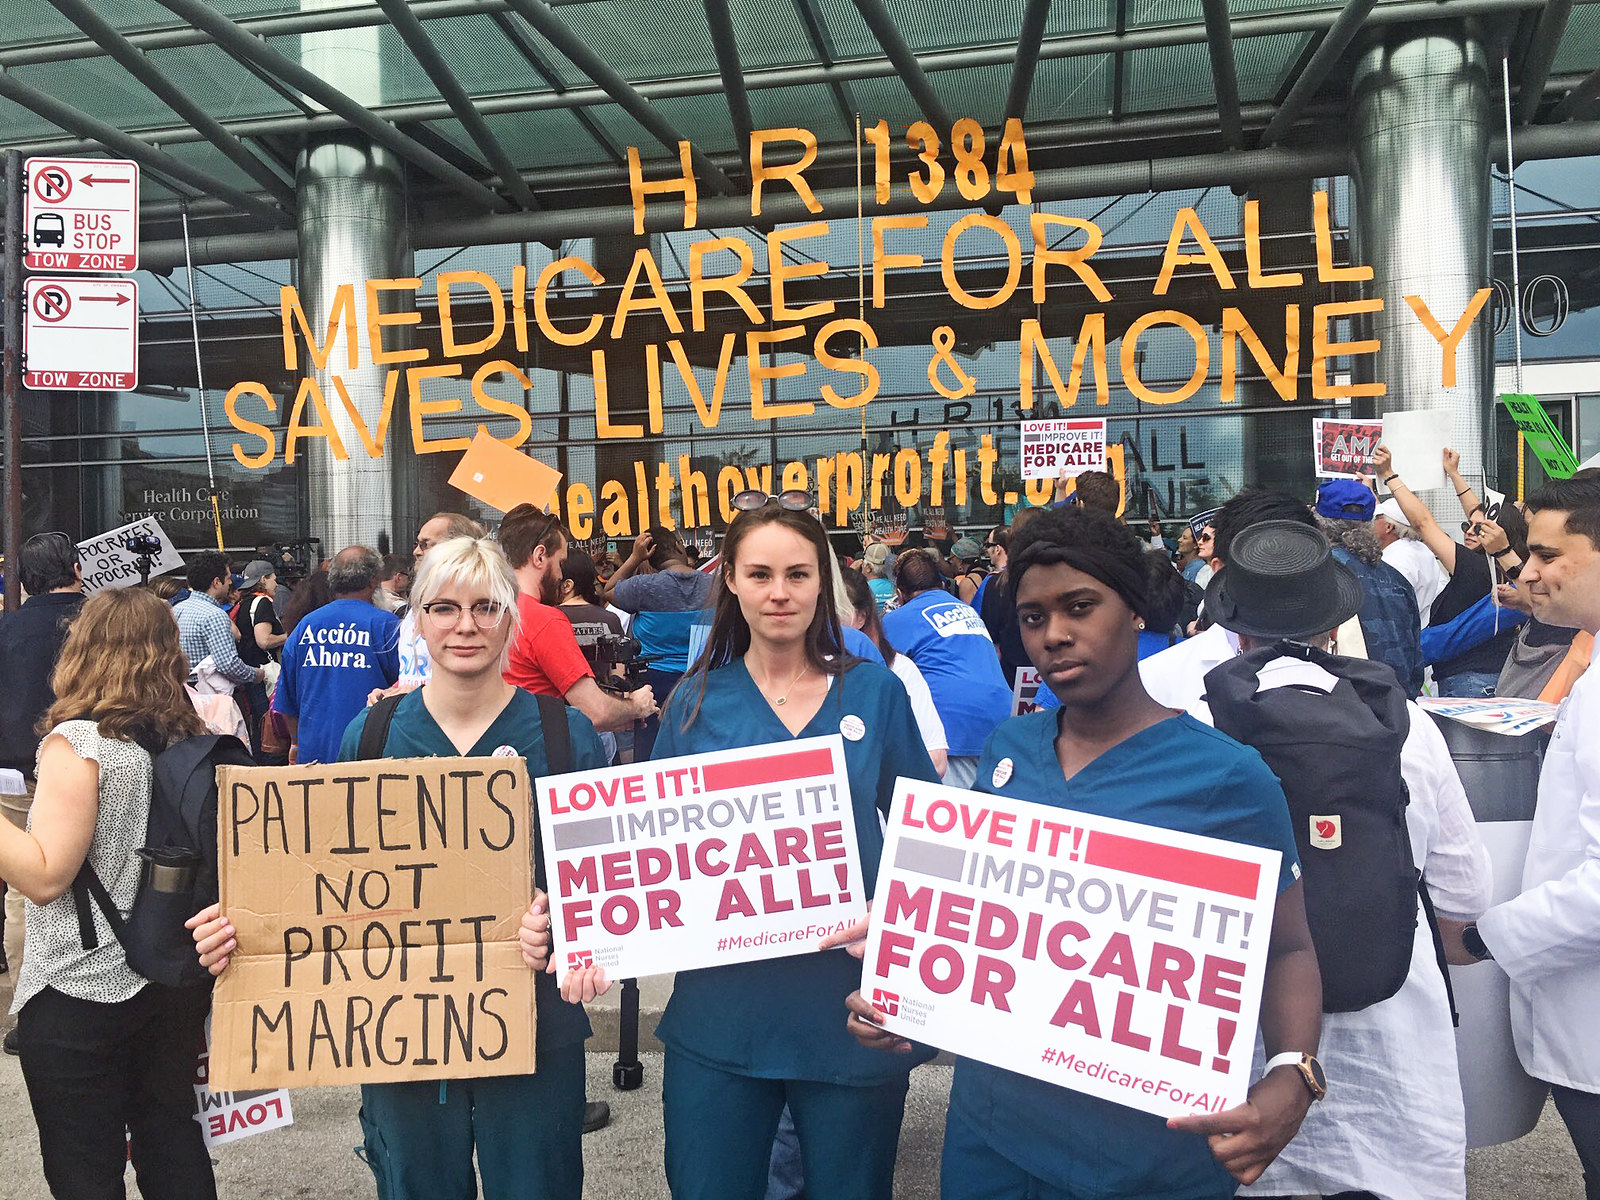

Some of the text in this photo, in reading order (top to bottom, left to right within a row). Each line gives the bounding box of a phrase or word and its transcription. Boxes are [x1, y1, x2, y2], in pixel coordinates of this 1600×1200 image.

[627, 116, 1036, 236] H R 1384
[73, 213, 112, 231] BUS
[73, 233, 122, 250] STOP
[32, 253, 127, 269] TOW ZONE
[280, 189, 1375, 371] MEDICARE FOR ALL
[31, 371, 126, 388] TOW ZONE
[224, 359, 535, 470] SAVES
[592, 317, 880, 441] LIVES
[926, 324, 978, 400] &
[1023, 422, 1067, 432] LOVE IT!
[1041, 431, 1103, 442] IMPROVE IT!
[1023, 441, 1103, 456] MEDICARE
[1023, 453, 1103, 469] FOR ALL!
[143, 487, 191, 503] Health
[170, 505, 259, 523] Corpoation
[96, 553, 124, 570] OR
[298, 622, 371, 648] Acción
[573, 627, 604, 635] ATLES
[302, 646, 372, 669] Ahora.
[1021, 671, 1043, 685] LO
[549, 766, 701, 815] LOVE IT!
[232, 769, 517, 857] PATIENTS
[616, 783, 840, 842] IMPROVE IT!
[901, 793, 1085, 862] LOVE IT!
[556, 820, 846, 898] MEDICARE
[315, 862, 439, 915] NOT
[561, 862, 852, 942] FOR ALL!
[967, 852, 1254, 950] IMPROVE IT!
[283, 915, 497, 987] PROFIT
[594, 945, 624, 955] National
[883, 879, 1247, 1014] MEDICARE
[875, 930, 1238, 1075] FOR ALL!
[901, 1005, 928, 1018] Nurses
[902, 996, 935, 1012] National
[251, 987, 509, 1074] MARGINS
[900, 1013, 926, 1026] United
[207, 1097, 284, 1138] LOVE
